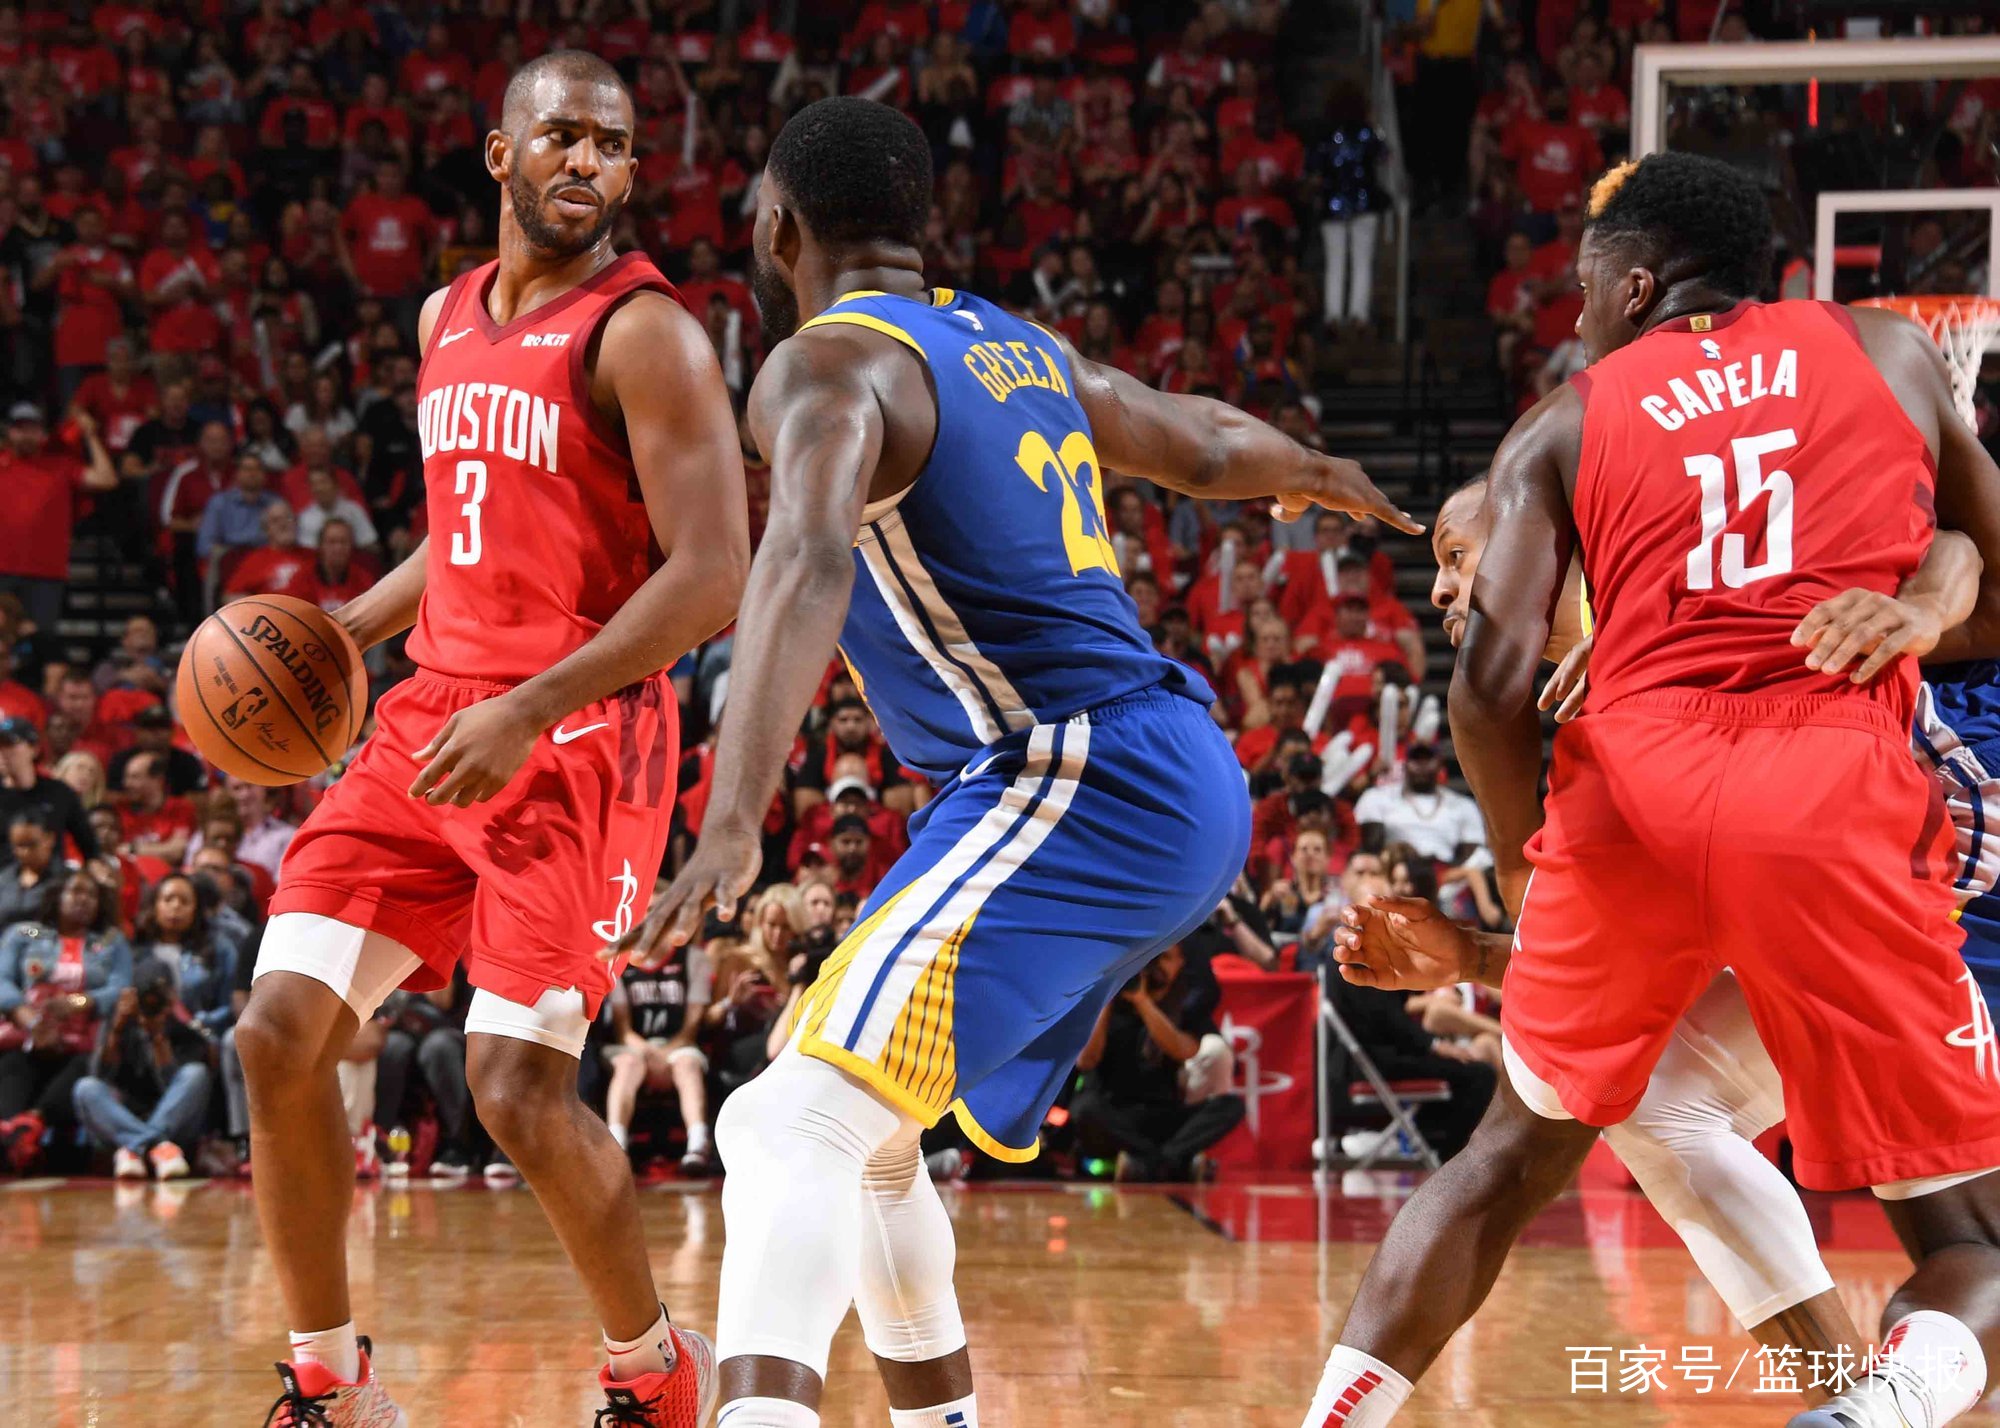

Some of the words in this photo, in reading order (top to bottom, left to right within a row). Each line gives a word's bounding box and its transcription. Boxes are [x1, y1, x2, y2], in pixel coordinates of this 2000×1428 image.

[963, 341, 1070, 403] GREEN
[1640, 349, 1798, 432] CAPELA
[450, 460, 488, 566] 3
[1014, 430, 1122, 578] 23
[1683, 428, 1798, 590] 15
[240, 615, 340, 735] SPALDING
